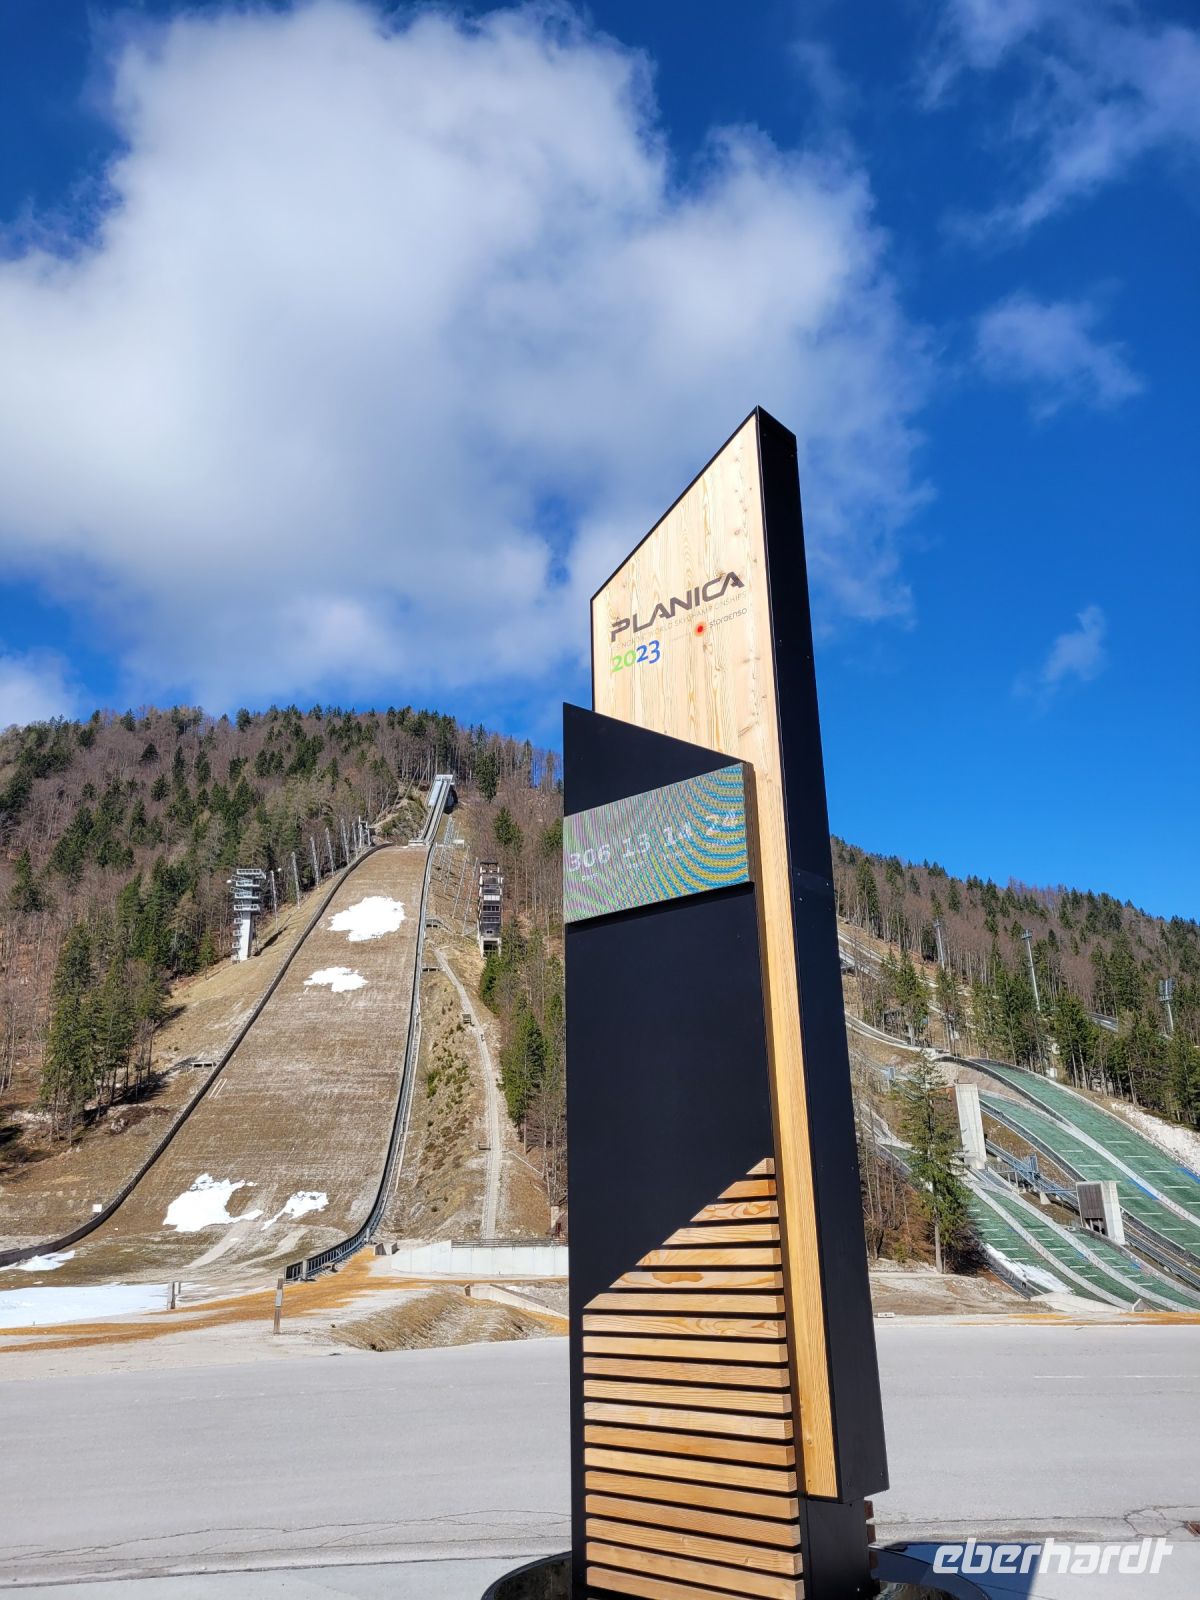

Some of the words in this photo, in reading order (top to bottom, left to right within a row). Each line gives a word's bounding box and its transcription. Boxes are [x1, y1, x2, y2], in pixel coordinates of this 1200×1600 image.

[610, 571, 745, 643] PLANICA
[611, 639, 661, 673] 2023
[568, 844, 611, 872] 306
